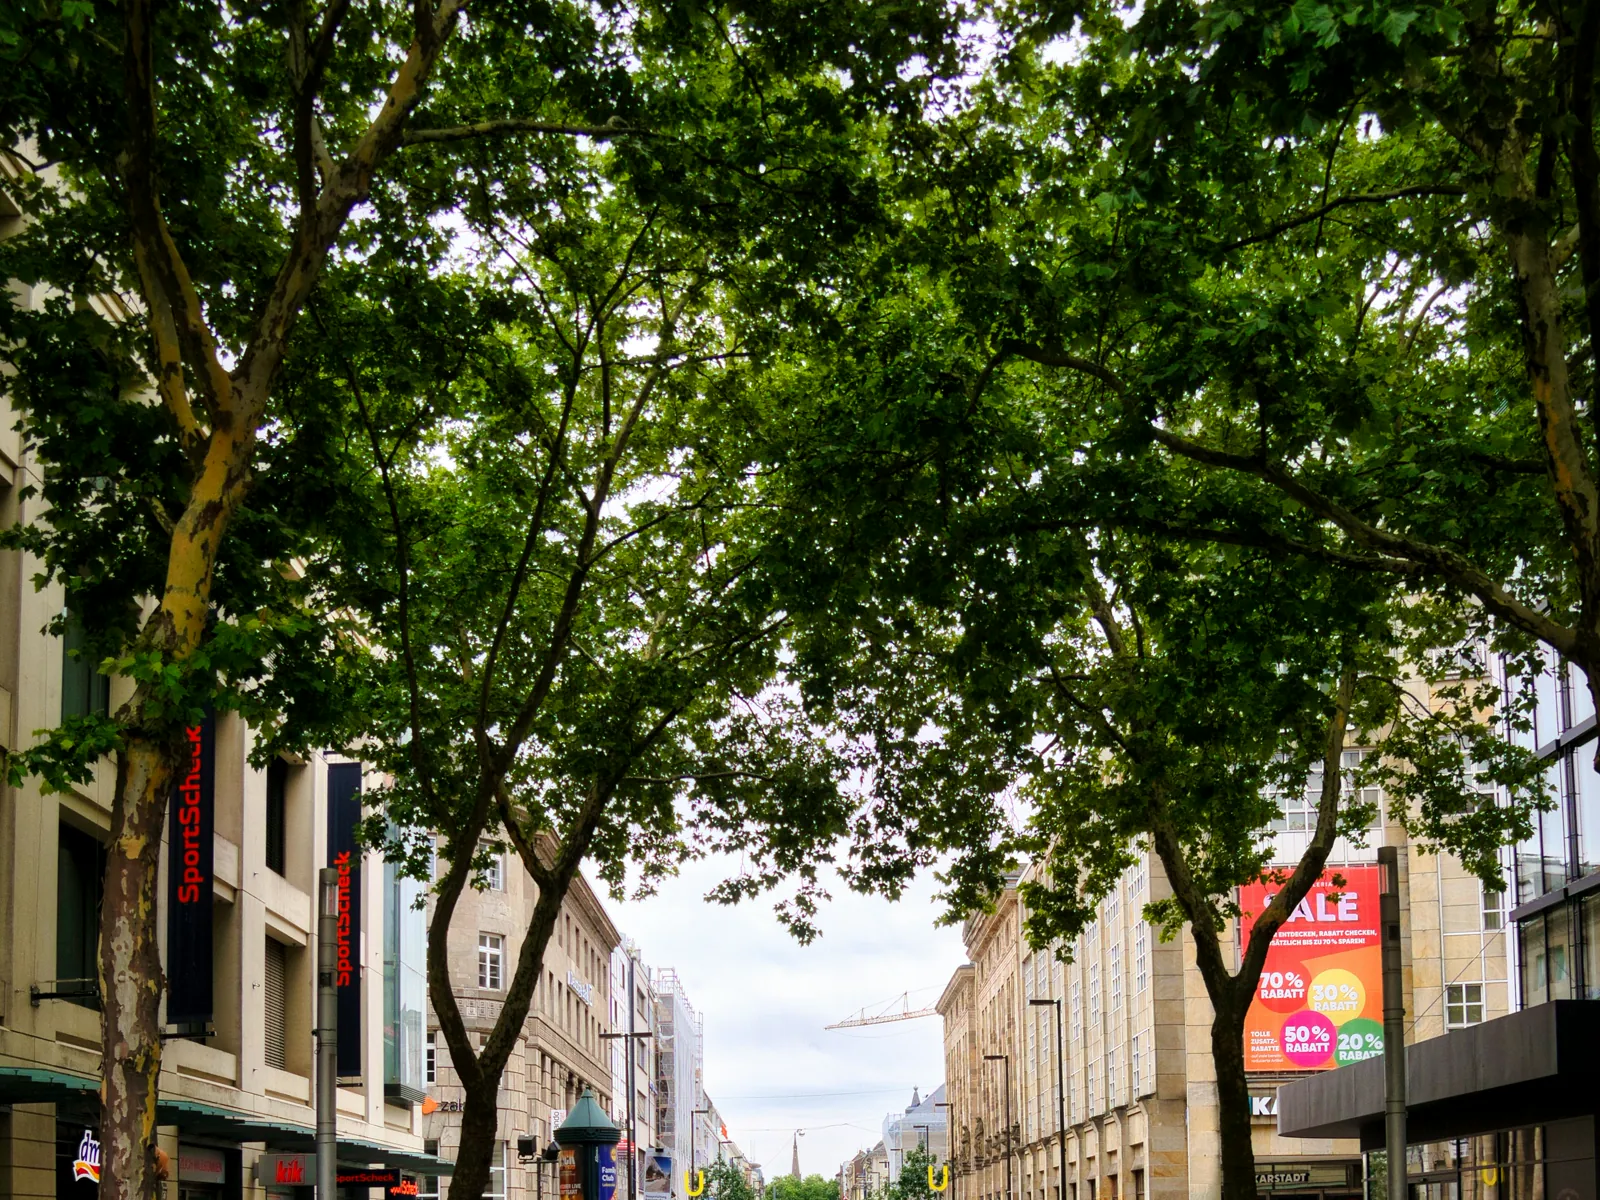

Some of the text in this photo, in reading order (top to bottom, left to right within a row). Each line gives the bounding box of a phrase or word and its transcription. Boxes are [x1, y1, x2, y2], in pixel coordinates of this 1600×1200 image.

[1344, 929, 1377, 937] CHECKEN,
[1260, 972, 1304, 989] 70 %
[1261, 989, 1304, 999] RABATT
[1312, 984, 1358, 1001] 30 %
[1314, 1001, 1358, 1011] RABATT
[1284, 1025, 1330, 1043] 50 %
[1337, 1033, 1383, 1050] 20 %
[1285, 1043, 1330, 1053] RABATT
[440, 1098, 465, 1112] zal
[80, 1131, 100, 1164] dm
[276, 1160, 304, 1183] kik
[336, 1173, 395, 1183] SportScheck
[928, 1165, 949, 1192] U
[684, 1170, 704, 1197] U
